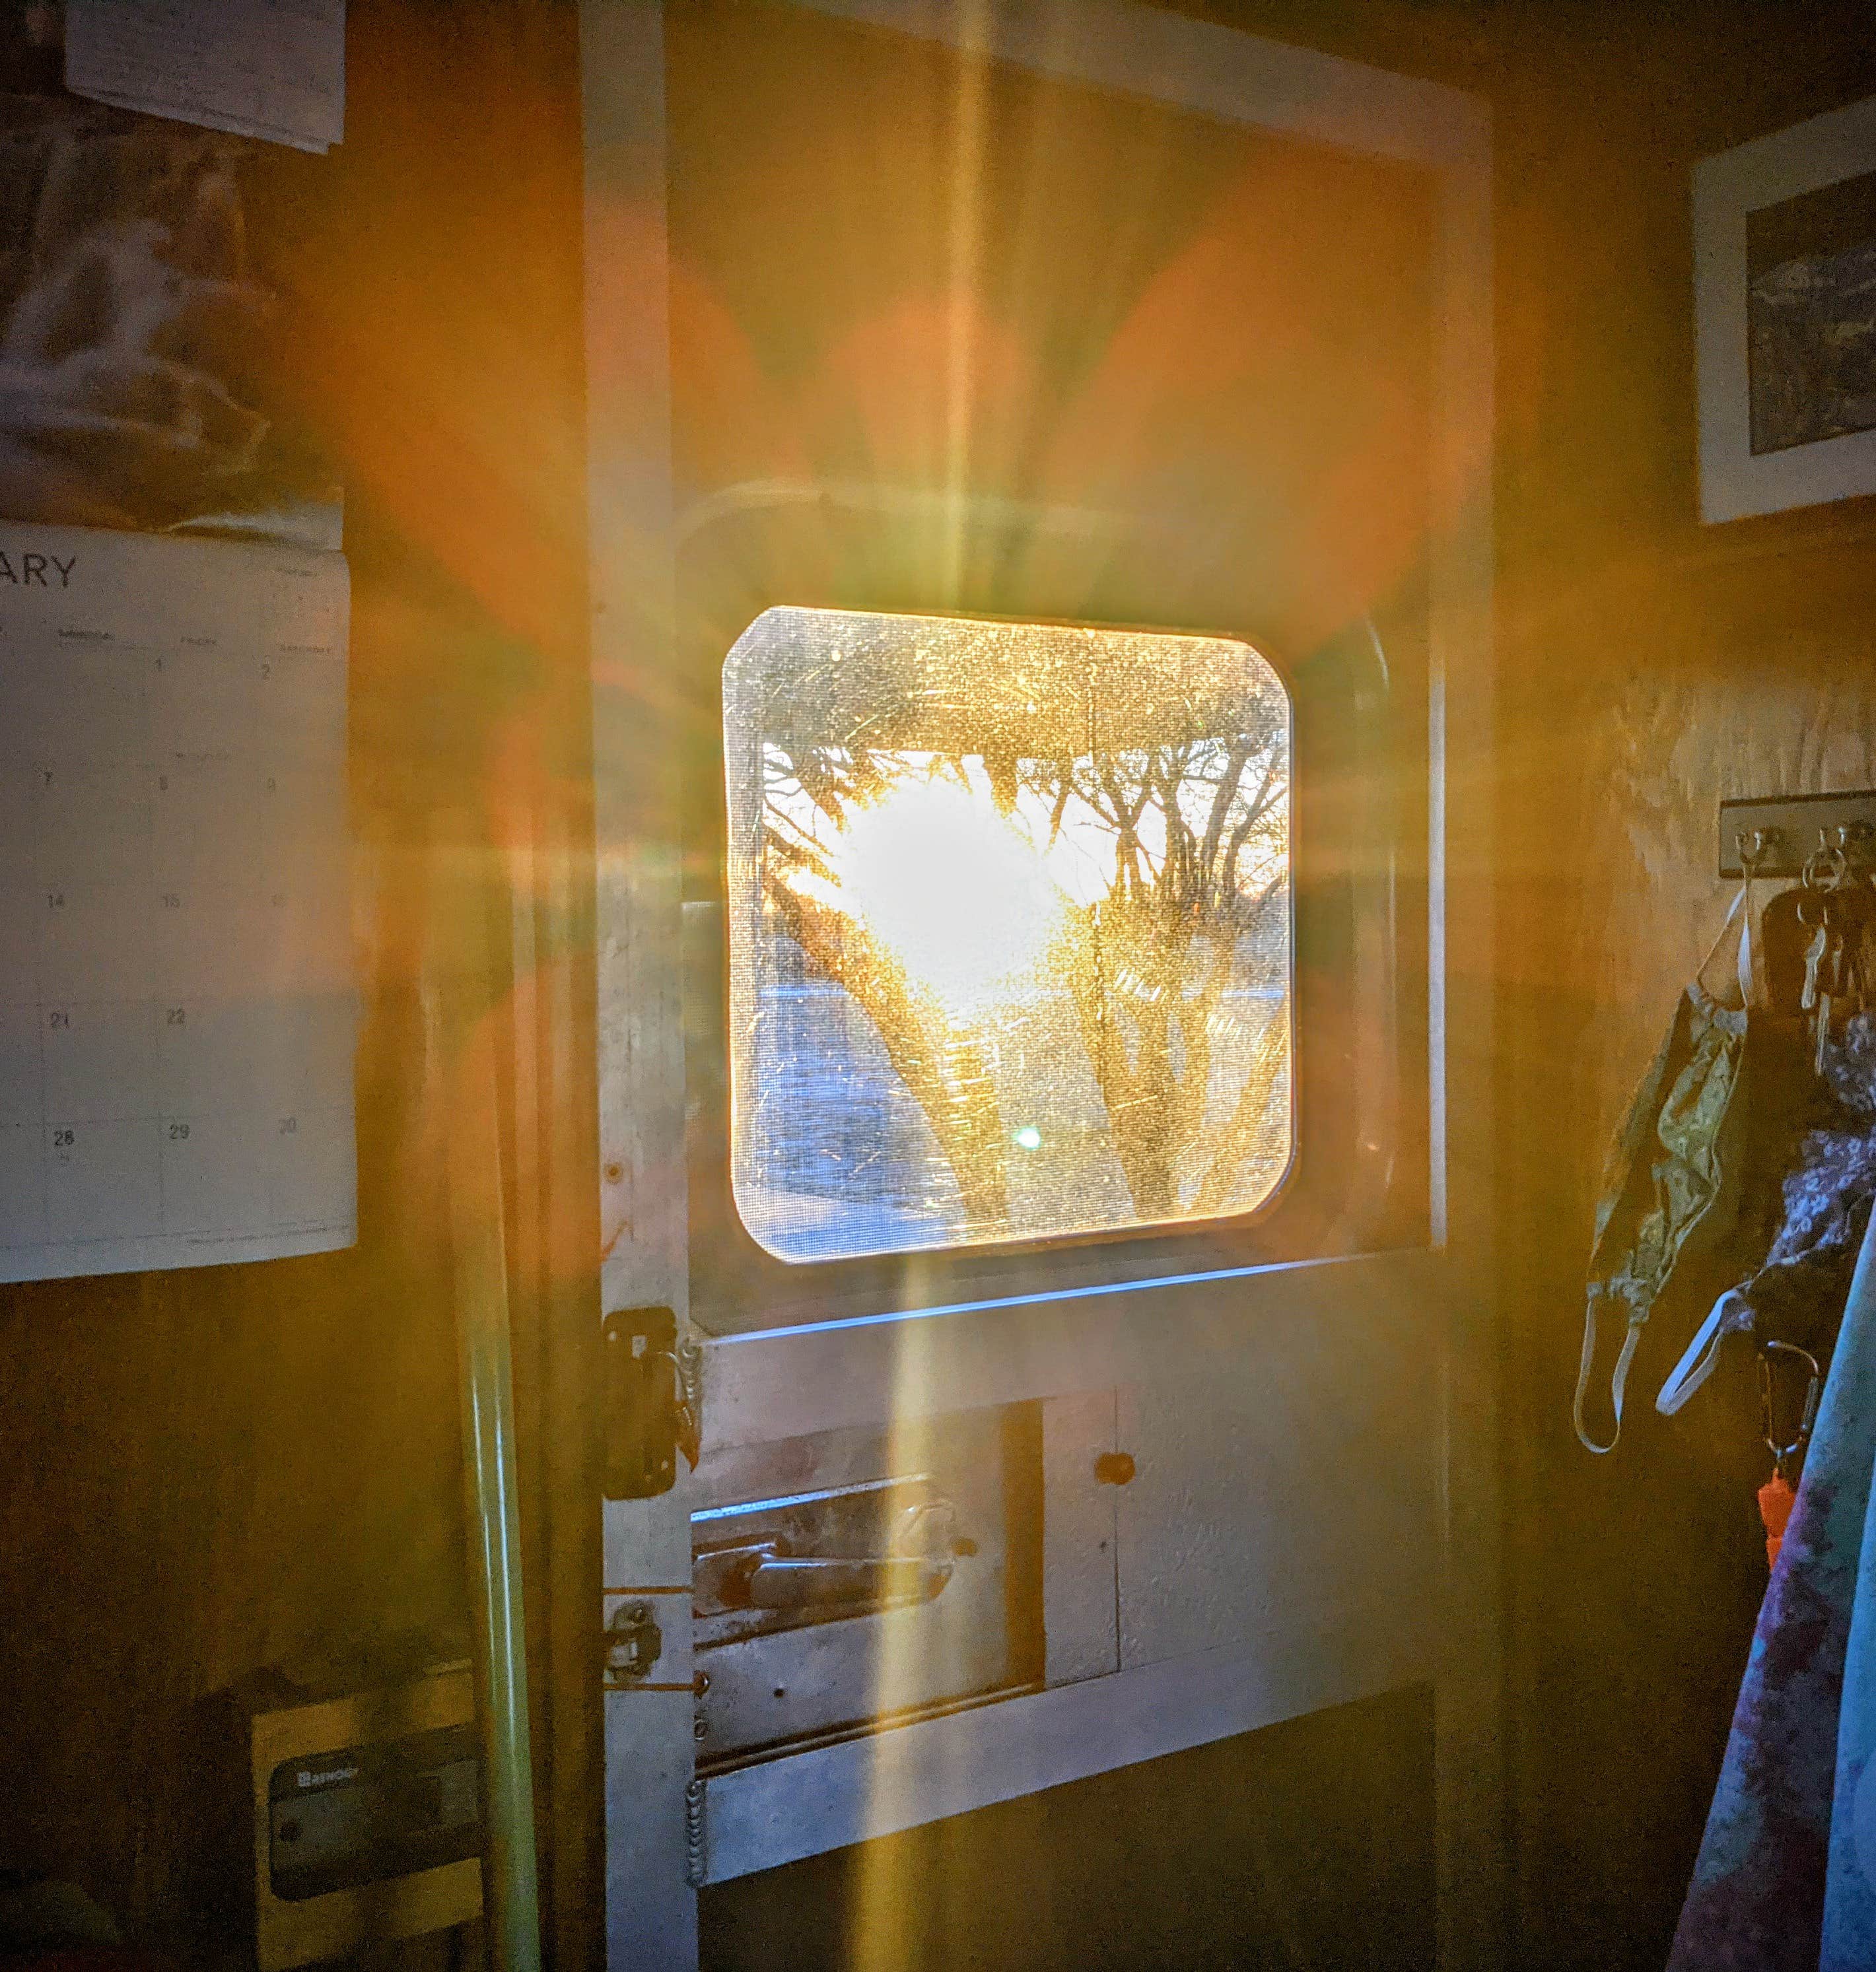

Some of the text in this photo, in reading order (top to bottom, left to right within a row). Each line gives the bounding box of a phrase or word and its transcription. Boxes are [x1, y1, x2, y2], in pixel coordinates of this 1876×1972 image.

[0, 551, 76, 588] ARY
[261, 663, 271, 680] 2
[50, 1012, 69, 1029] 21
[166, 1008, 186, 1025] 22
[53, 1130, 75, 1147] 28
[169, 1124, 190, 1140] 29
